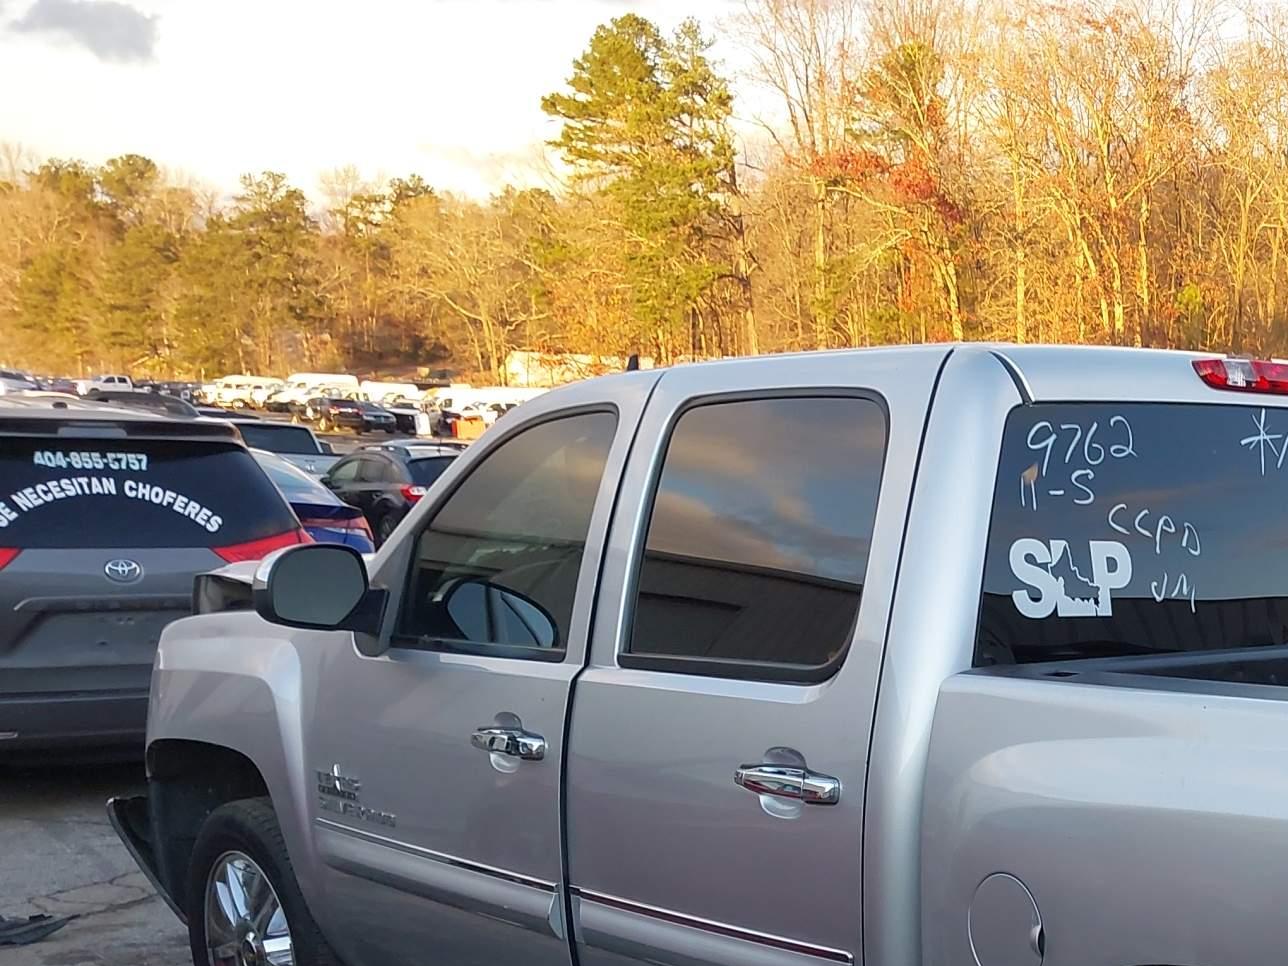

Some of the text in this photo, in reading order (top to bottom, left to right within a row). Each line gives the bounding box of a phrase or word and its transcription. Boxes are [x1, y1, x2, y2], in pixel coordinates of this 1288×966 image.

[1027, 416, 1138, 477] 9762
[10, 477, 117, 511] NECESITAN
[123, 480, 223, 532] CHOFERES
